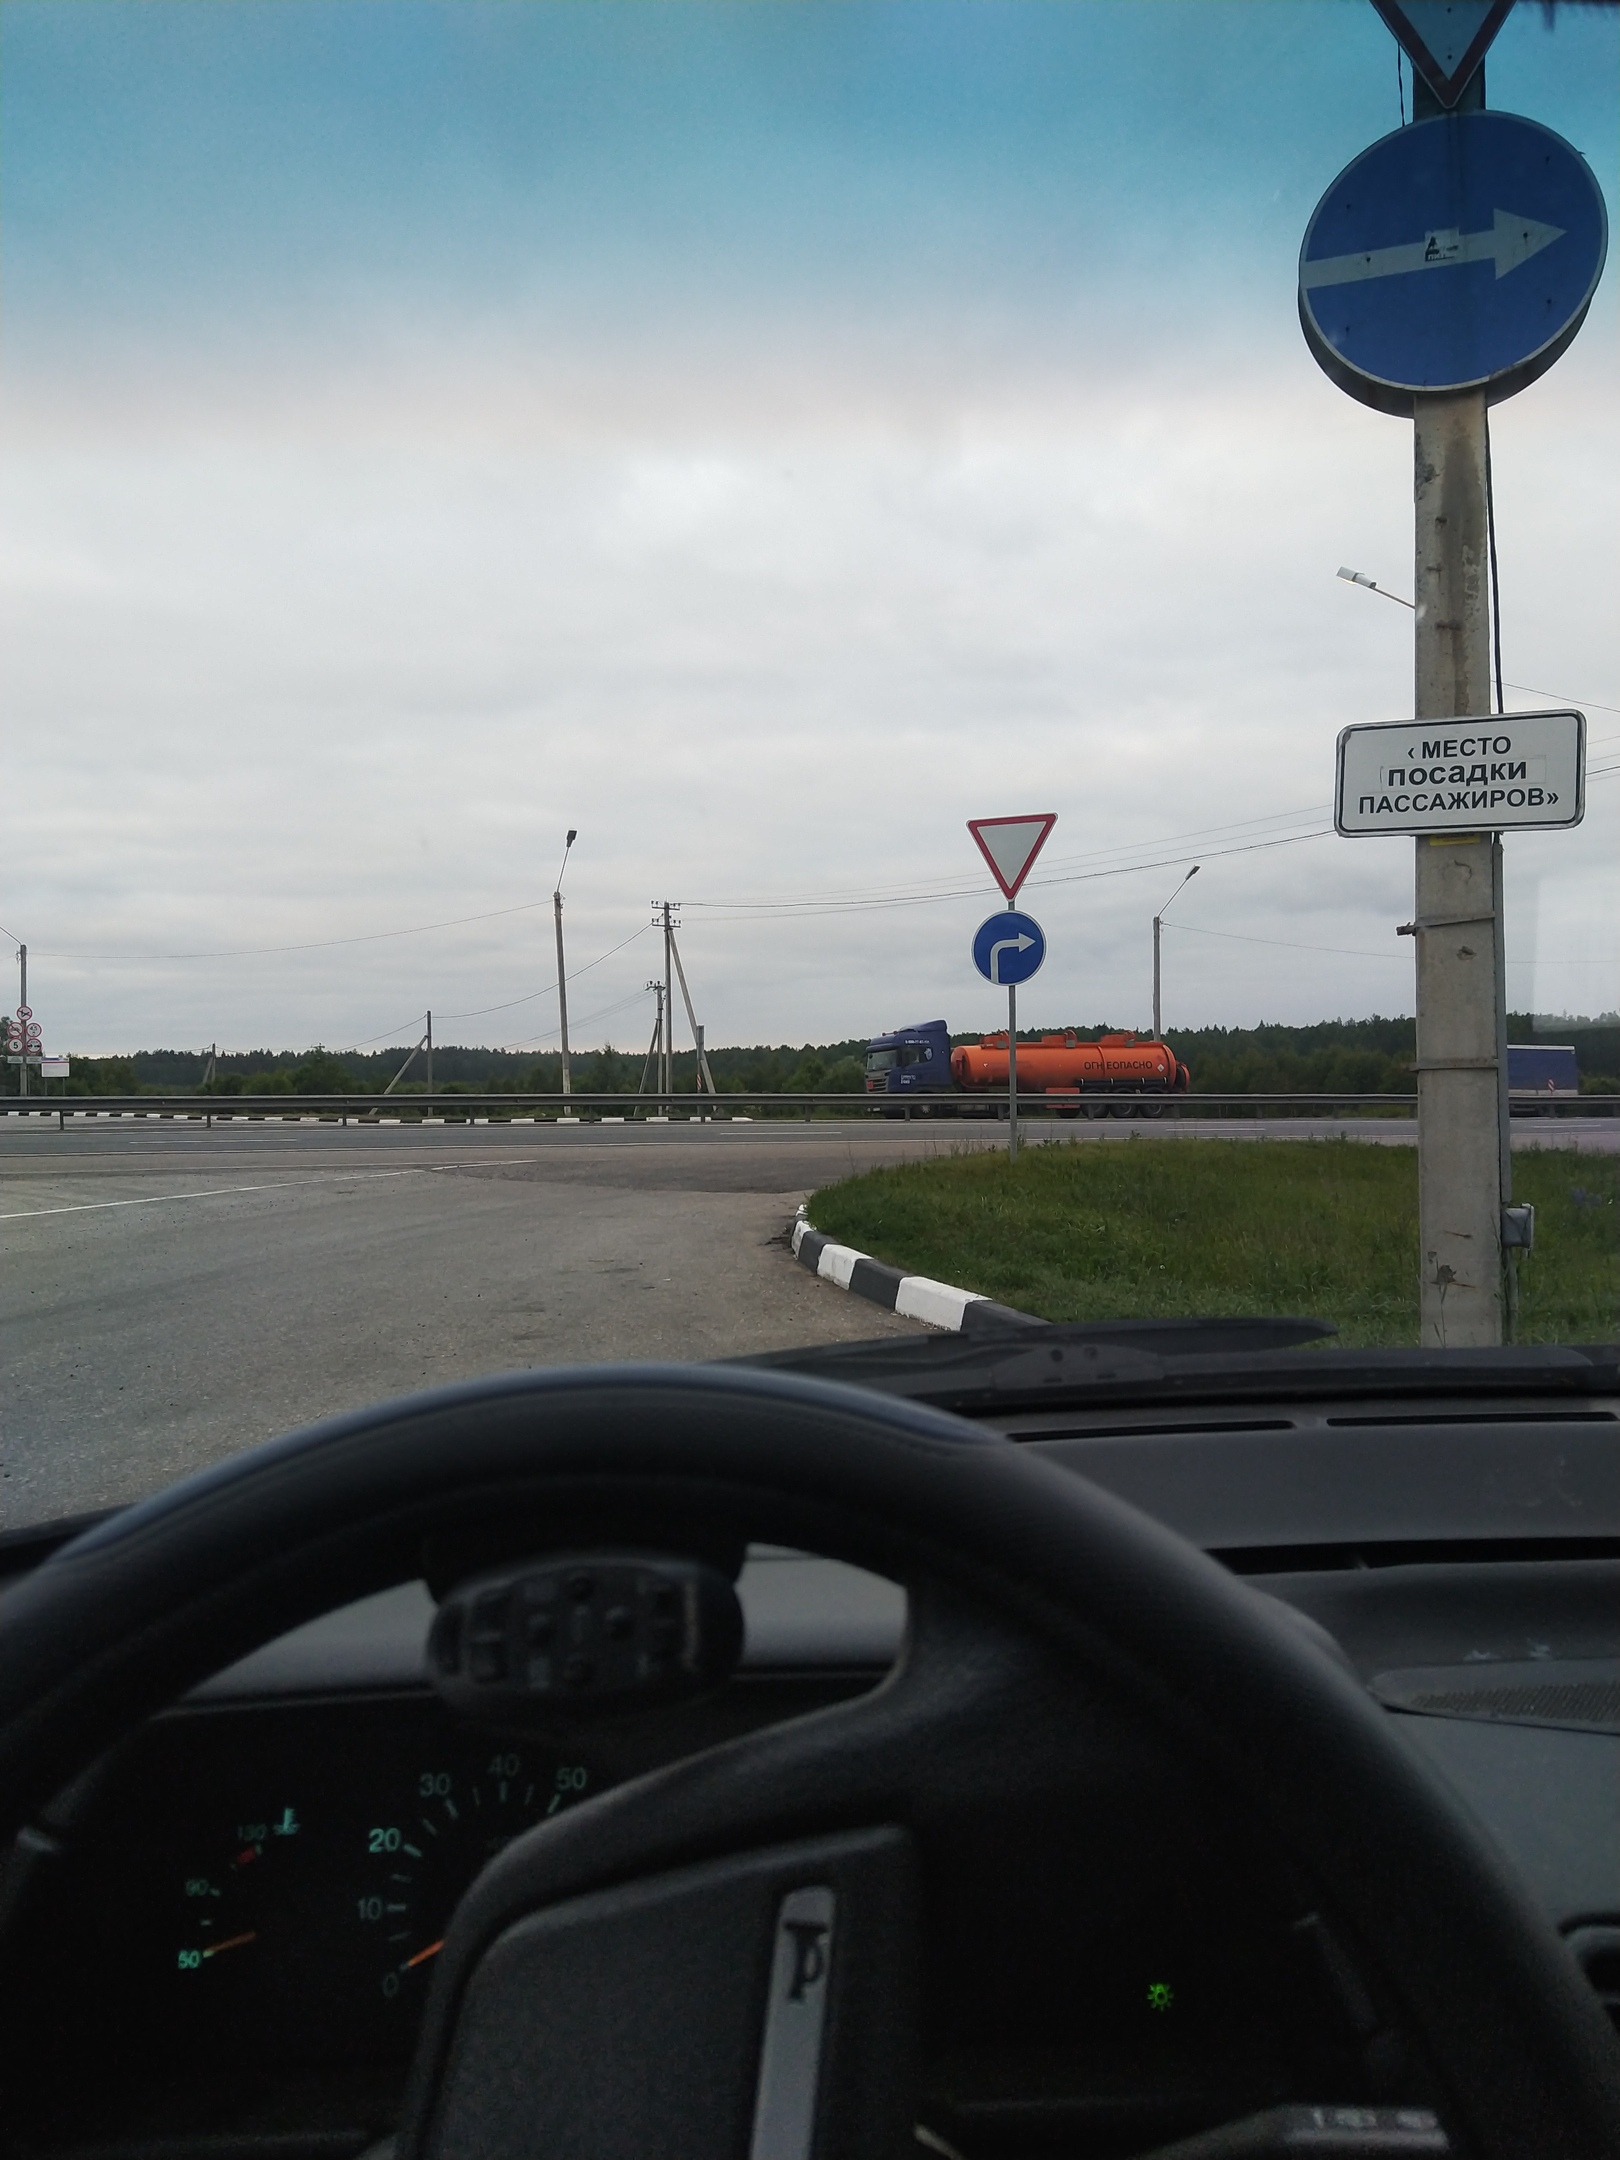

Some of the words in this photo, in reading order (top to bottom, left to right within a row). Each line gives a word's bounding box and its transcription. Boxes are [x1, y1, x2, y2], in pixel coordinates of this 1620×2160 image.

[1387, 761, 1527, 787] посадки
[1084, 1060, 1153, 1070] ОГНЕОПАСНО
[419, 1772, 451, 1796] 30
[555, 1766, 588, 1790] 50
[368, 1828, 401, 1854] 20
[357, 1898, 382, 1921] 10
